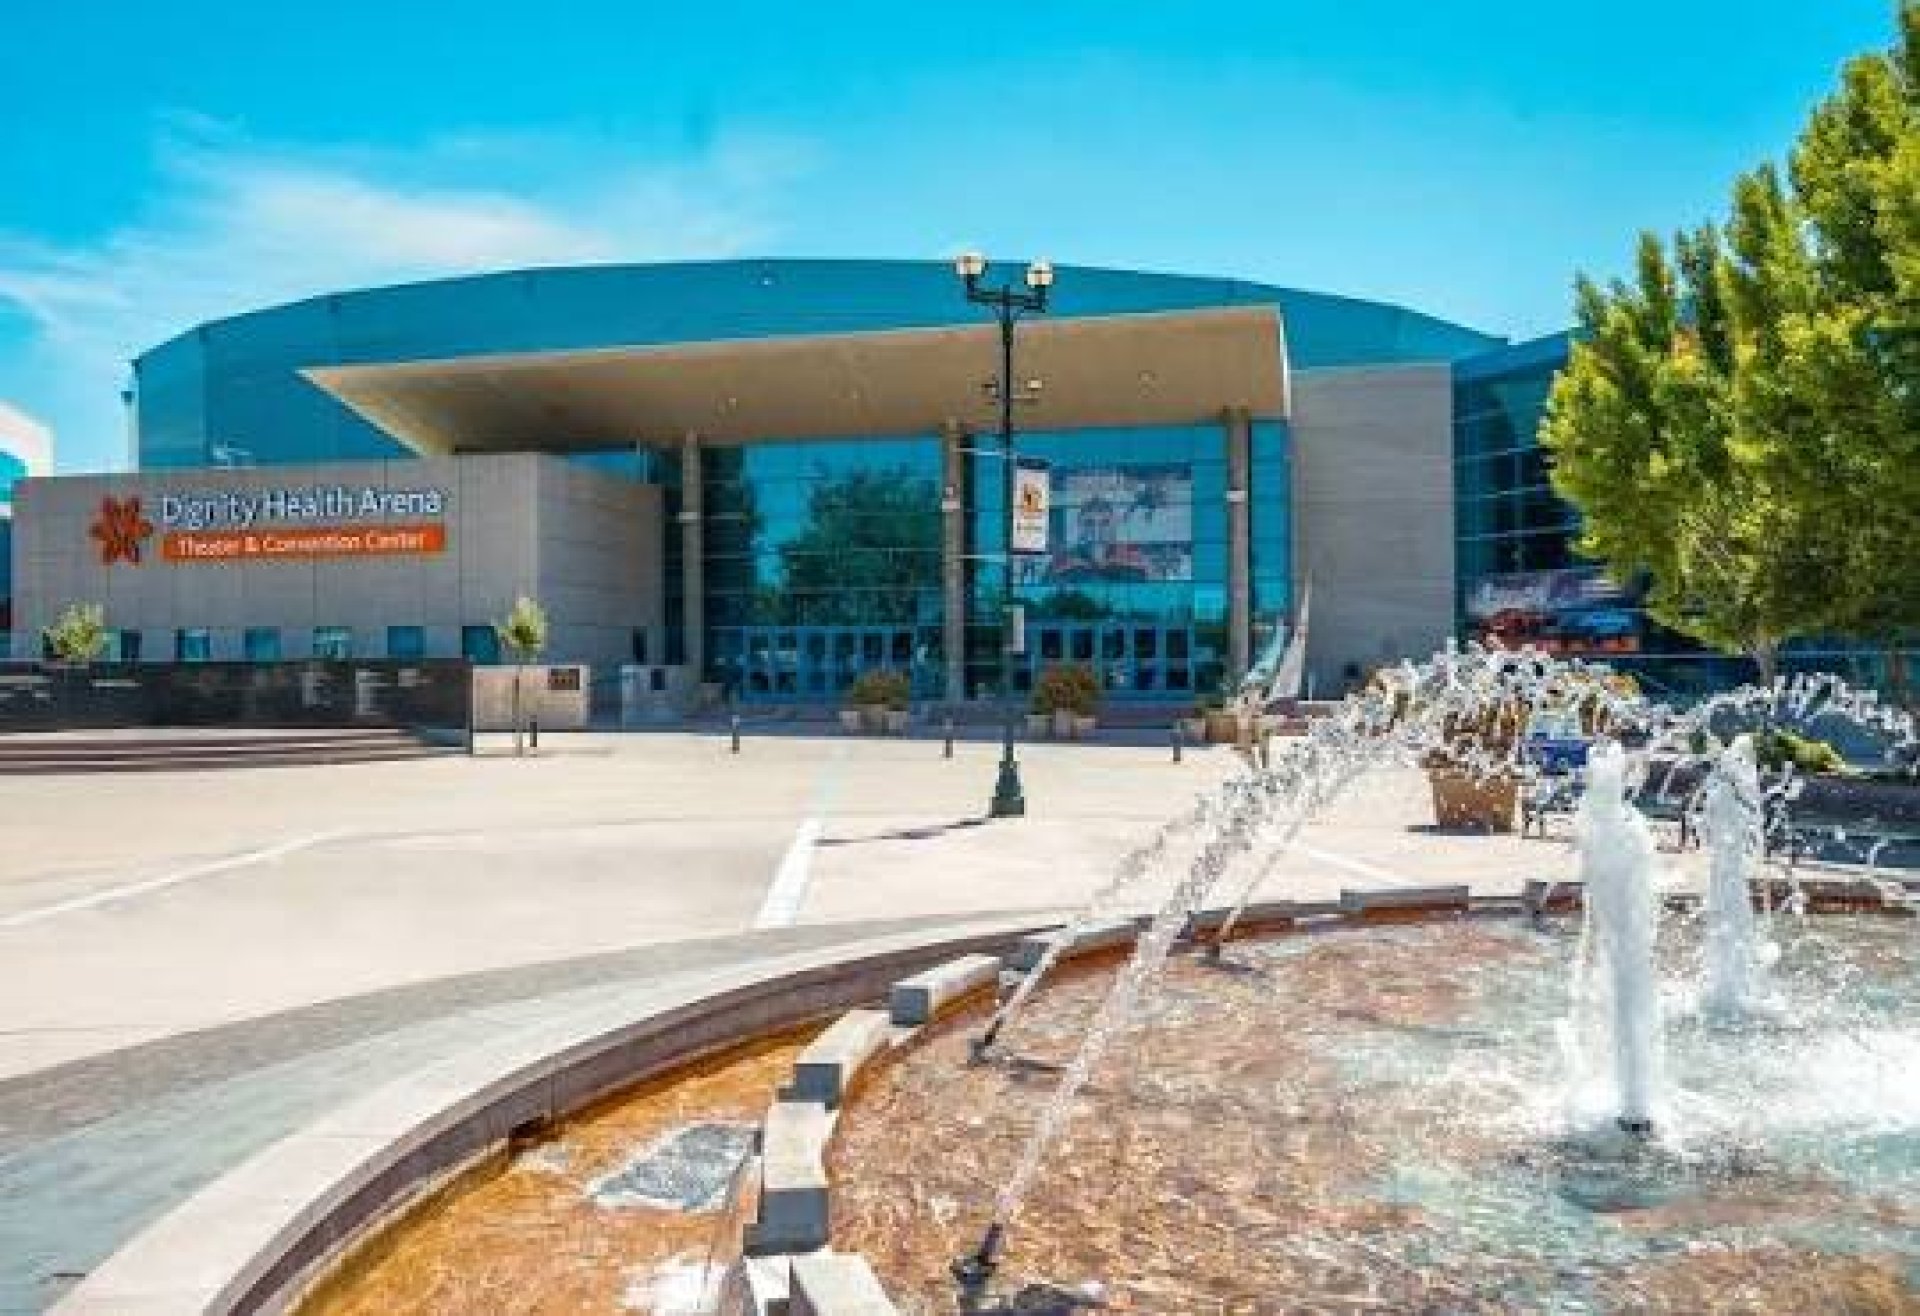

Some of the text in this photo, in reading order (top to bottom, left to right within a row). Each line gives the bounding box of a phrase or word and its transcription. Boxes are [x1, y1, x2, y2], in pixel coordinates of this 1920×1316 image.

[162, 487, 442, 530] Dignity Health Arena
[177, 532, 424, 556] Theater & Convention Center
